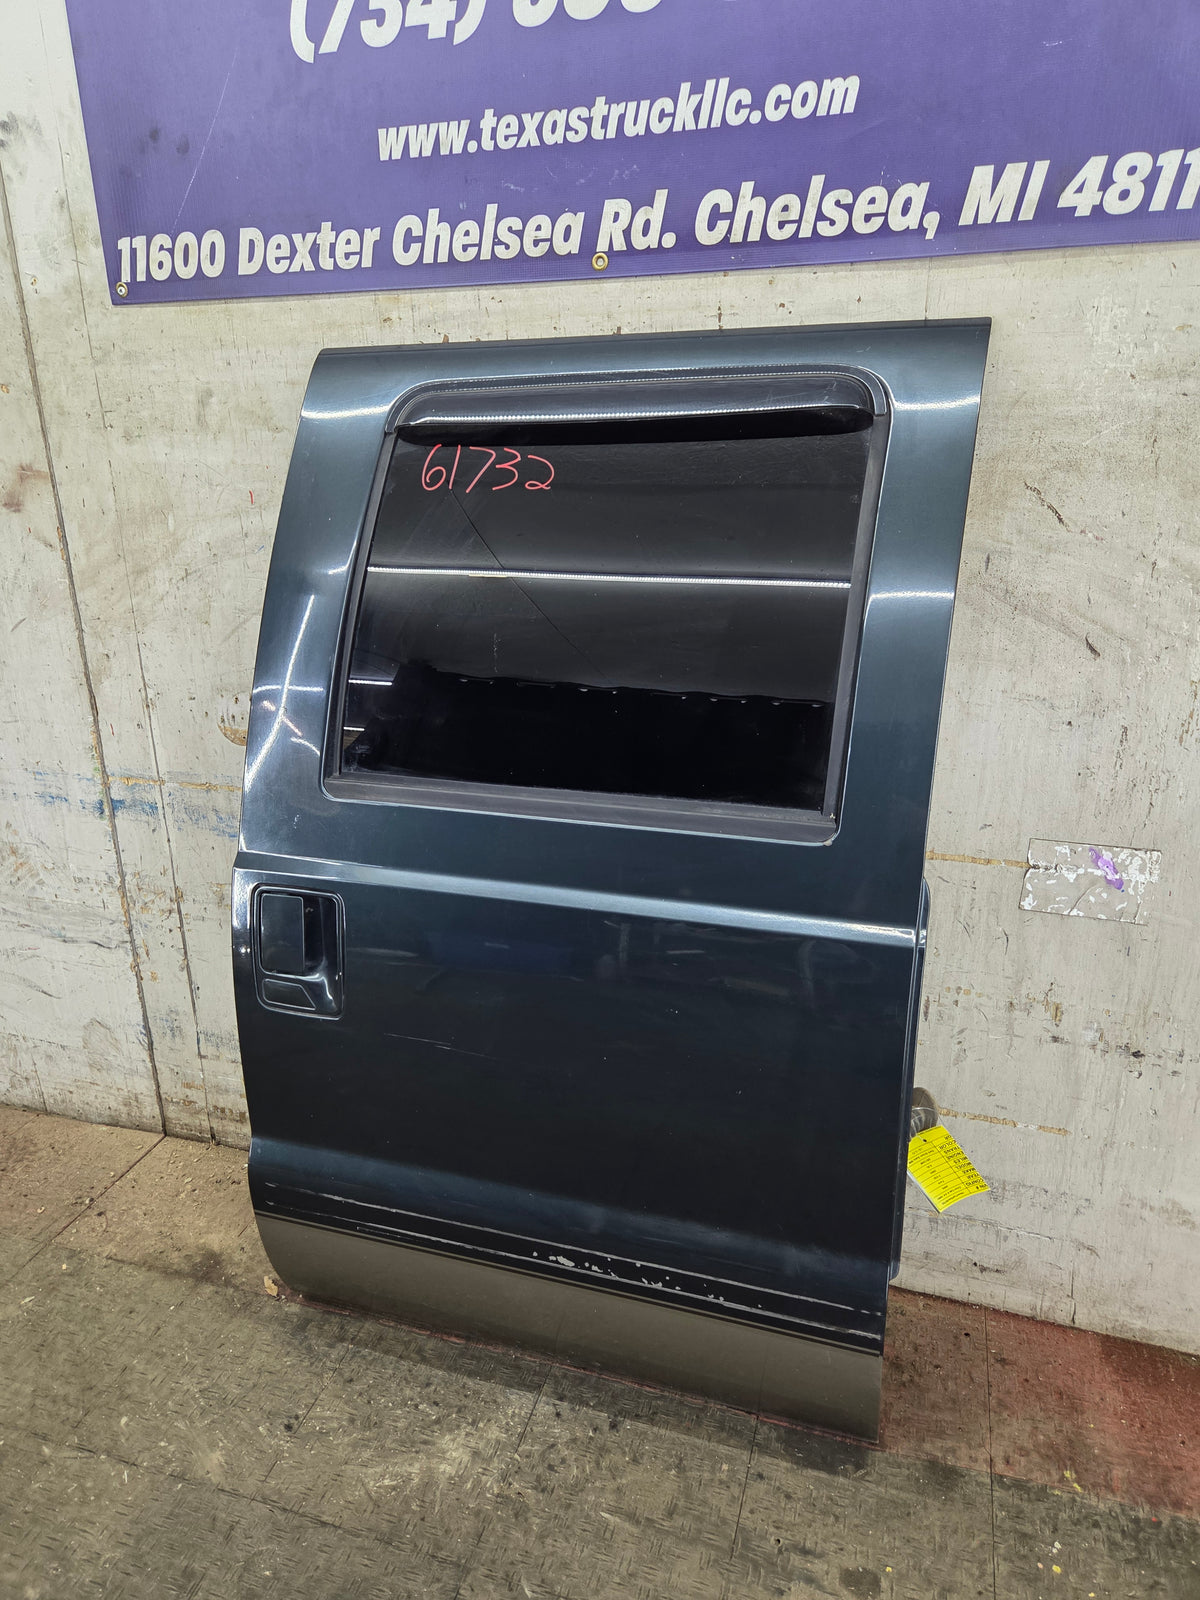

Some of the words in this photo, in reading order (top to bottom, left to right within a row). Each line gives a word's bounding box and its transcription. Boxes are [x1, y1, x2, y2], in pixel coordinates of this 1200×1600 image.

[377, 74, 861, 162] www.texastruckllc.com
[116, 228, 226, 285] 11600
[237, 226, 382, 276] Dexter
[392, 202, 586, 266] Chelsea
[595, 188, 677, 253] Rd.
[694, 173, 941, 241] Chelsea,
[957, 159, 1051, 228] MI
[1056, 146, 1200, 218] 4811
[421, 443, 556, 494] 61732
